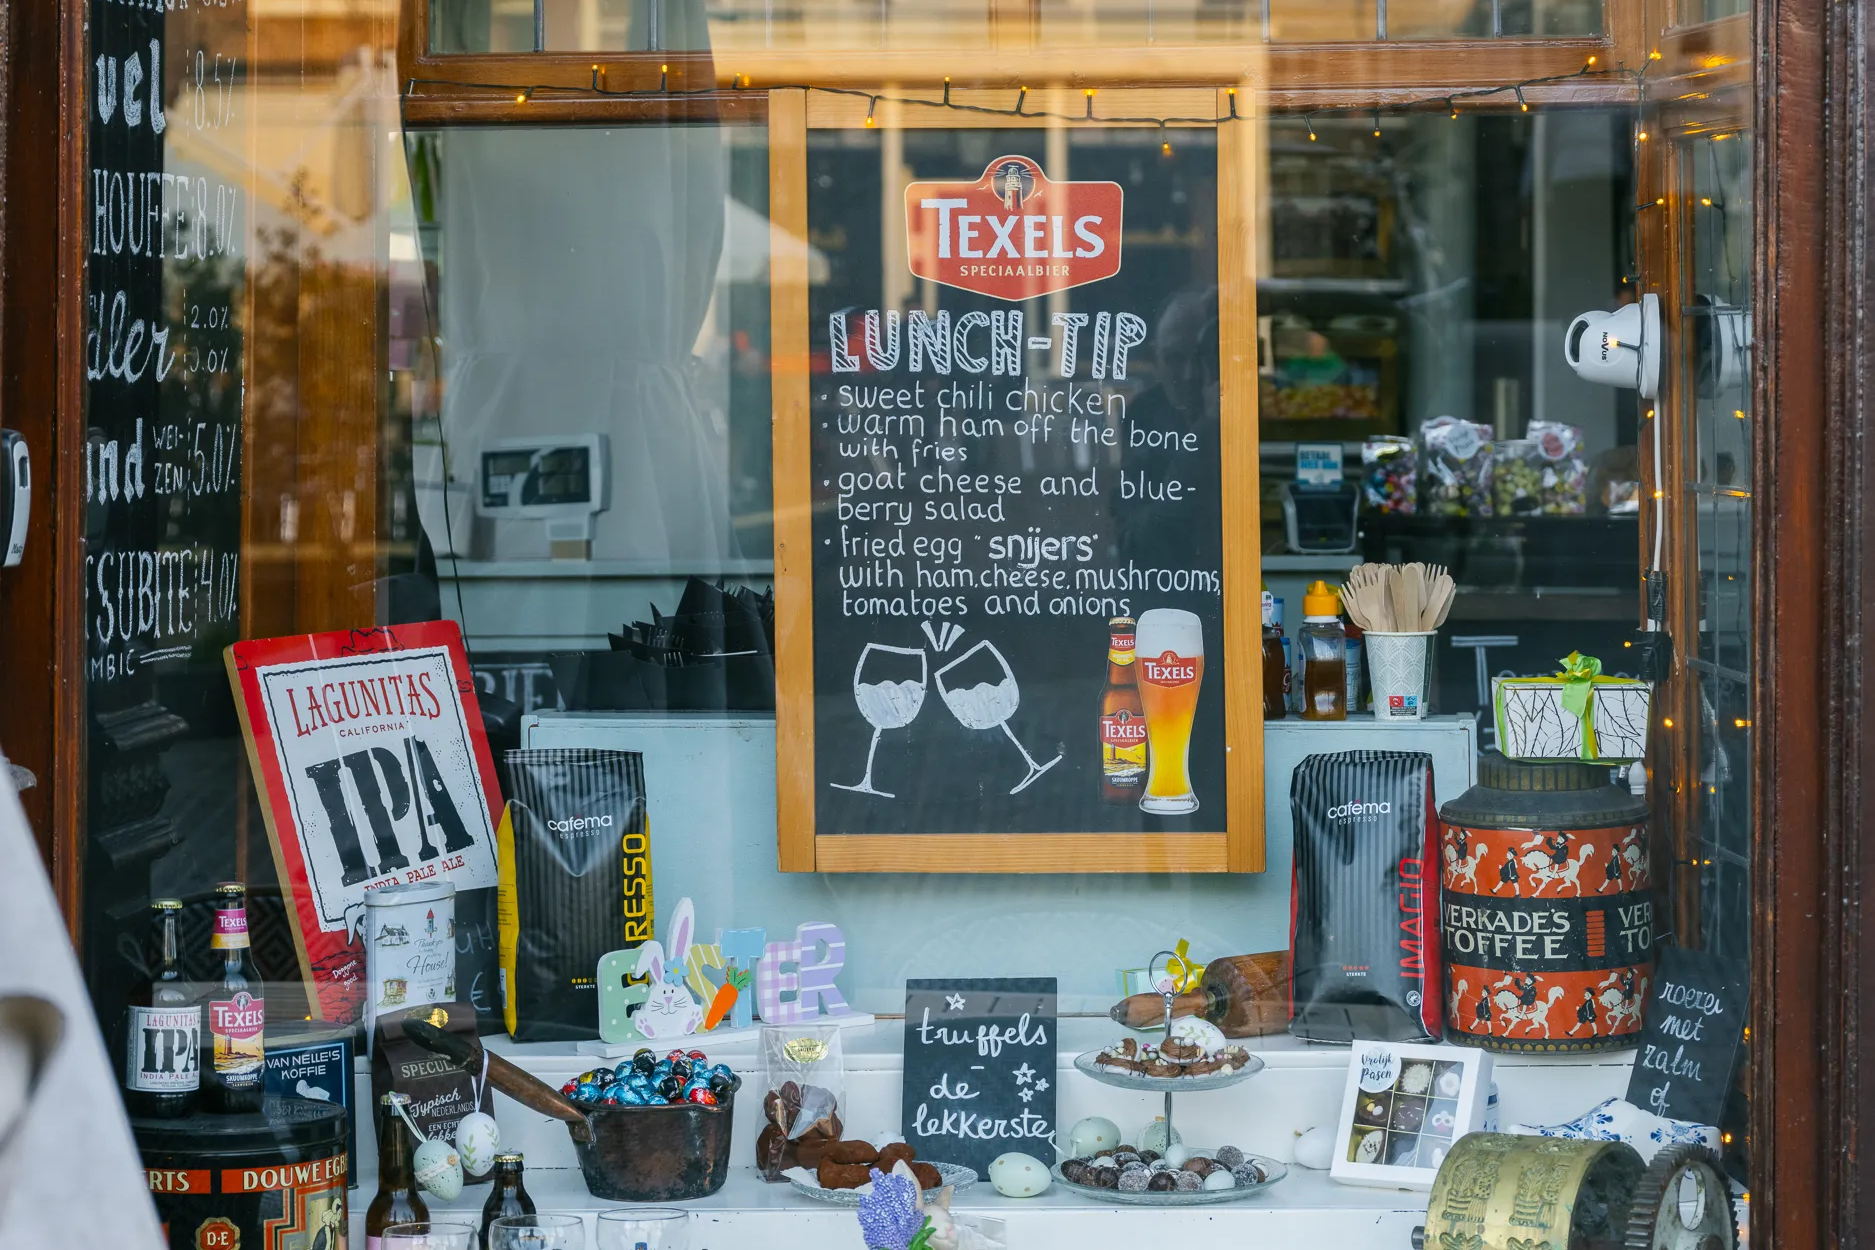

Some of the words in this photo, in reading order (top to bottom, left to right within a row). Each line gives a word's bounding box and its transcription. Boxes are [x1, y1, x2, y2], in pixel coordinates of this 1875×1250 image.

[93, 168, 189, 260] HOUFFE
[959, 265, 1070, 278] SPECIAALBIER
[829, 308, 1147, 380] LUNCH-TIP
[838, 380, 925, 410] sweet
[937, 380, 993, 411] chili
[1005, 376, 1127, 419] chicken
[837, 412, 925, 436] warm
[939, 408, 1004, 438] ham
[1013, 413, 1053, 444] off
[1070, 418, 1118, 446] the
[1129, 417, 1199, 452] bone
[838, 438, 898, 461] with
[911, 438, 968, 467] fries
[153, 461, 184, 495] ZEN
[838, 465, 905, 500] goat
[919, 467, 1022, 496] cheese
[1039, 468, 1100, 496] and
[1119, 470, 1197, 501] blue-
[837, 495, 913, 526] berry
[925, 496, 1006, 523] salad
[840, 525, 905, 558] fried
[913, 535, 963, 564] egg
[838, 559, 904, 589] with
[1075, 559, 1221, 597] mushrooms,
[96, 549, 193, 644] SUBITE
[842, 591, 968, 617] tomatoes
[984, 590, 1040, 616] and
[1048, 595, 1131, 617] onions
[86, 649, 135, 682] MBIC
[286, 670, 442, 738] LAGUNITAS
[339, 722, 406, 738] CALIFORNIA
[304, 735, 475, 888] IPA
[547, 813, 613, 833] caféma
[1327, 798, 1391, 819] caféma
[1338, 815, 1378, 826] espresso
[559, 829, 601, 840] espresso
[406, 864, 437, 884] PALE
[441, 855, 465, 872] ALE
[622, 833, 649, 943] RESSO
[1443, 902, 1571, 934] VERKADE'S
[1445, 925, 1569, 960] TOFFEE
[1620, 923, 1653, 953] TO
[406, 951, 450, 976] House!
[343, 972, 359, 991] good
[597, 920, 852, 1044] ESTER
[146, 1014, 198, 1027] LAGUNITAS
[213, 1006, 264, 1028] TEXELS
[916, 1006, 1048, 1058] truffels
[1660, 1014, 1705, 1041] met
[141, 1027, 199, 1073] IPA
[266, 1056, 290, 1069] VAN
[292, 1050, 341, 1066] NELLE'S
[1361, 1052, 1395, 1069] Vrolijk
[1642, 1043, 1702, 1082] zalm
[140, 1072, 164, 1080] INDIA
[168, 1072, 189, 1080] PALE
[281, 1065, 327, 1080] KOFFIE
[401, 1059, 457, 1079] SPECUL
[1360, 1067, 1393, 1085] Pasen
[929, 1073, 981, 1099] de
[1650, 1081, 1671, 1118] of
[409, 1087, 461, 1118] Typisch
[428, 1123, 442, 1132] EEN
[911, 1102, 1055, 1141] lekkerste
[143, 1169, 190, 1192] RTS
[242, 1162, 322, 1191] DOUWE
